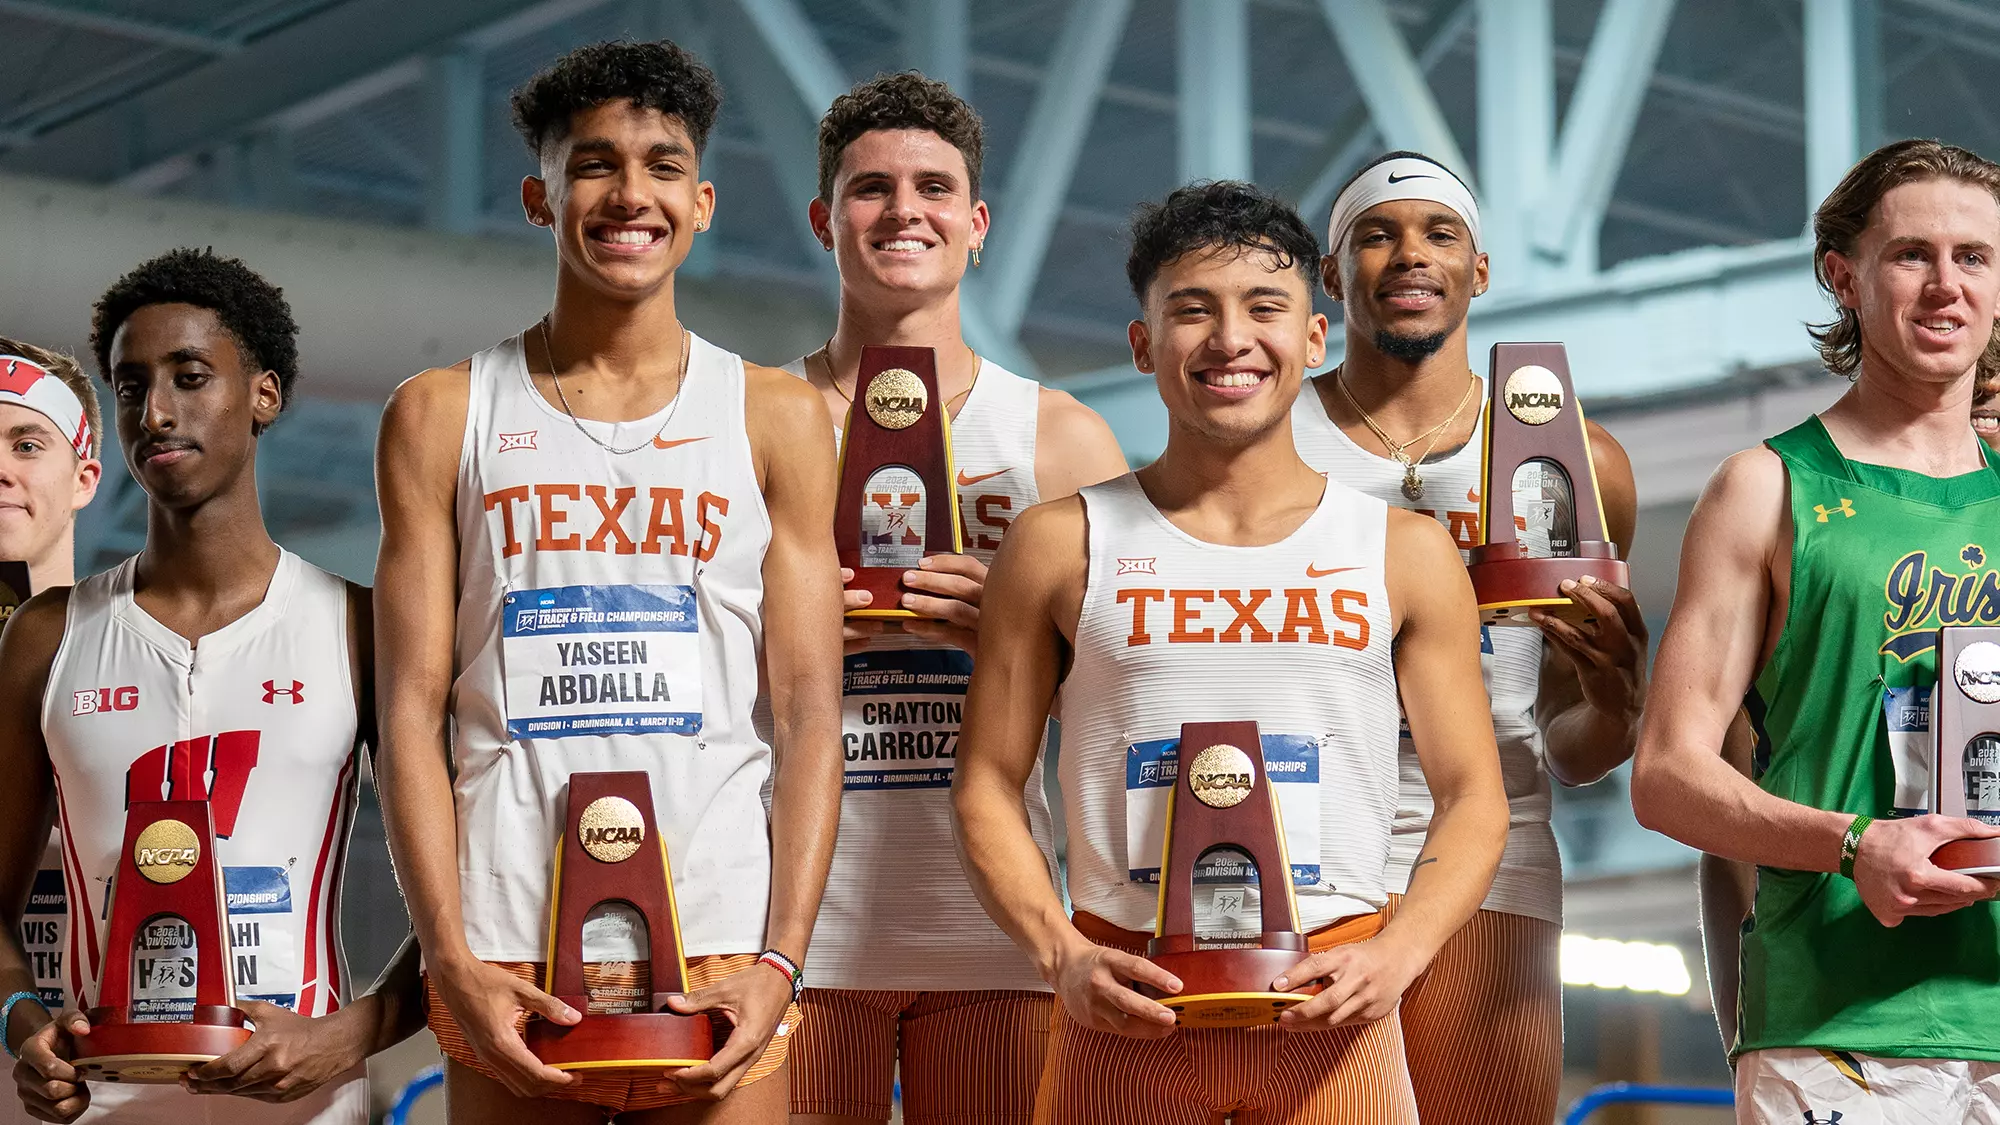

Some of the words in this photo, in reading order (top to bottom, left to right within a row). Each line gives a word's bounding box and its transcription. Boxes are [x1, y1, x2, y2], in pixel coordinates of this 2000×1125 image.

[873, 397, 923, 413] NCAA
[1510, 393, 1562, 409] NCAA
[885, 476, 908, 484] 2022
[876, 485, 912, 493] DIVISION
[484, 484, 729, 563] TEXAS
[539, 613, 569, 624] TRACK
[570, 612, 578, 623] &
[578, 612, 605, 622] FIELD
[606, 611, 685, 622] CHAMPIONSHIPS
[1116, 588, 1370, 651] TEXAS
[557, 640, 648, 666] YASEEN
[852, 675, 882, 685] TRACK
[882, 675, 890, 684] &
[890, 674, 914, 684] FIELD
[539, 672, 671, 706] ABDALLA
[862, 702, 962, 726] CRAYTON
[528, 722, 562, 732] DIVISION
[572, 718, 624, 728] BIRMINGHAM,
[624, 718, 635, 726] AL
[640, 718, 667, 726] MARCH
[668, 717, 684, 726] 11-12
[883, 773, 932, 783] BIRMINGHAM,
[1194, 774, 1251, 791] NCAA
[584, 827, 643, 844] NCAA
[139, 848, 196, 866] NCAA
